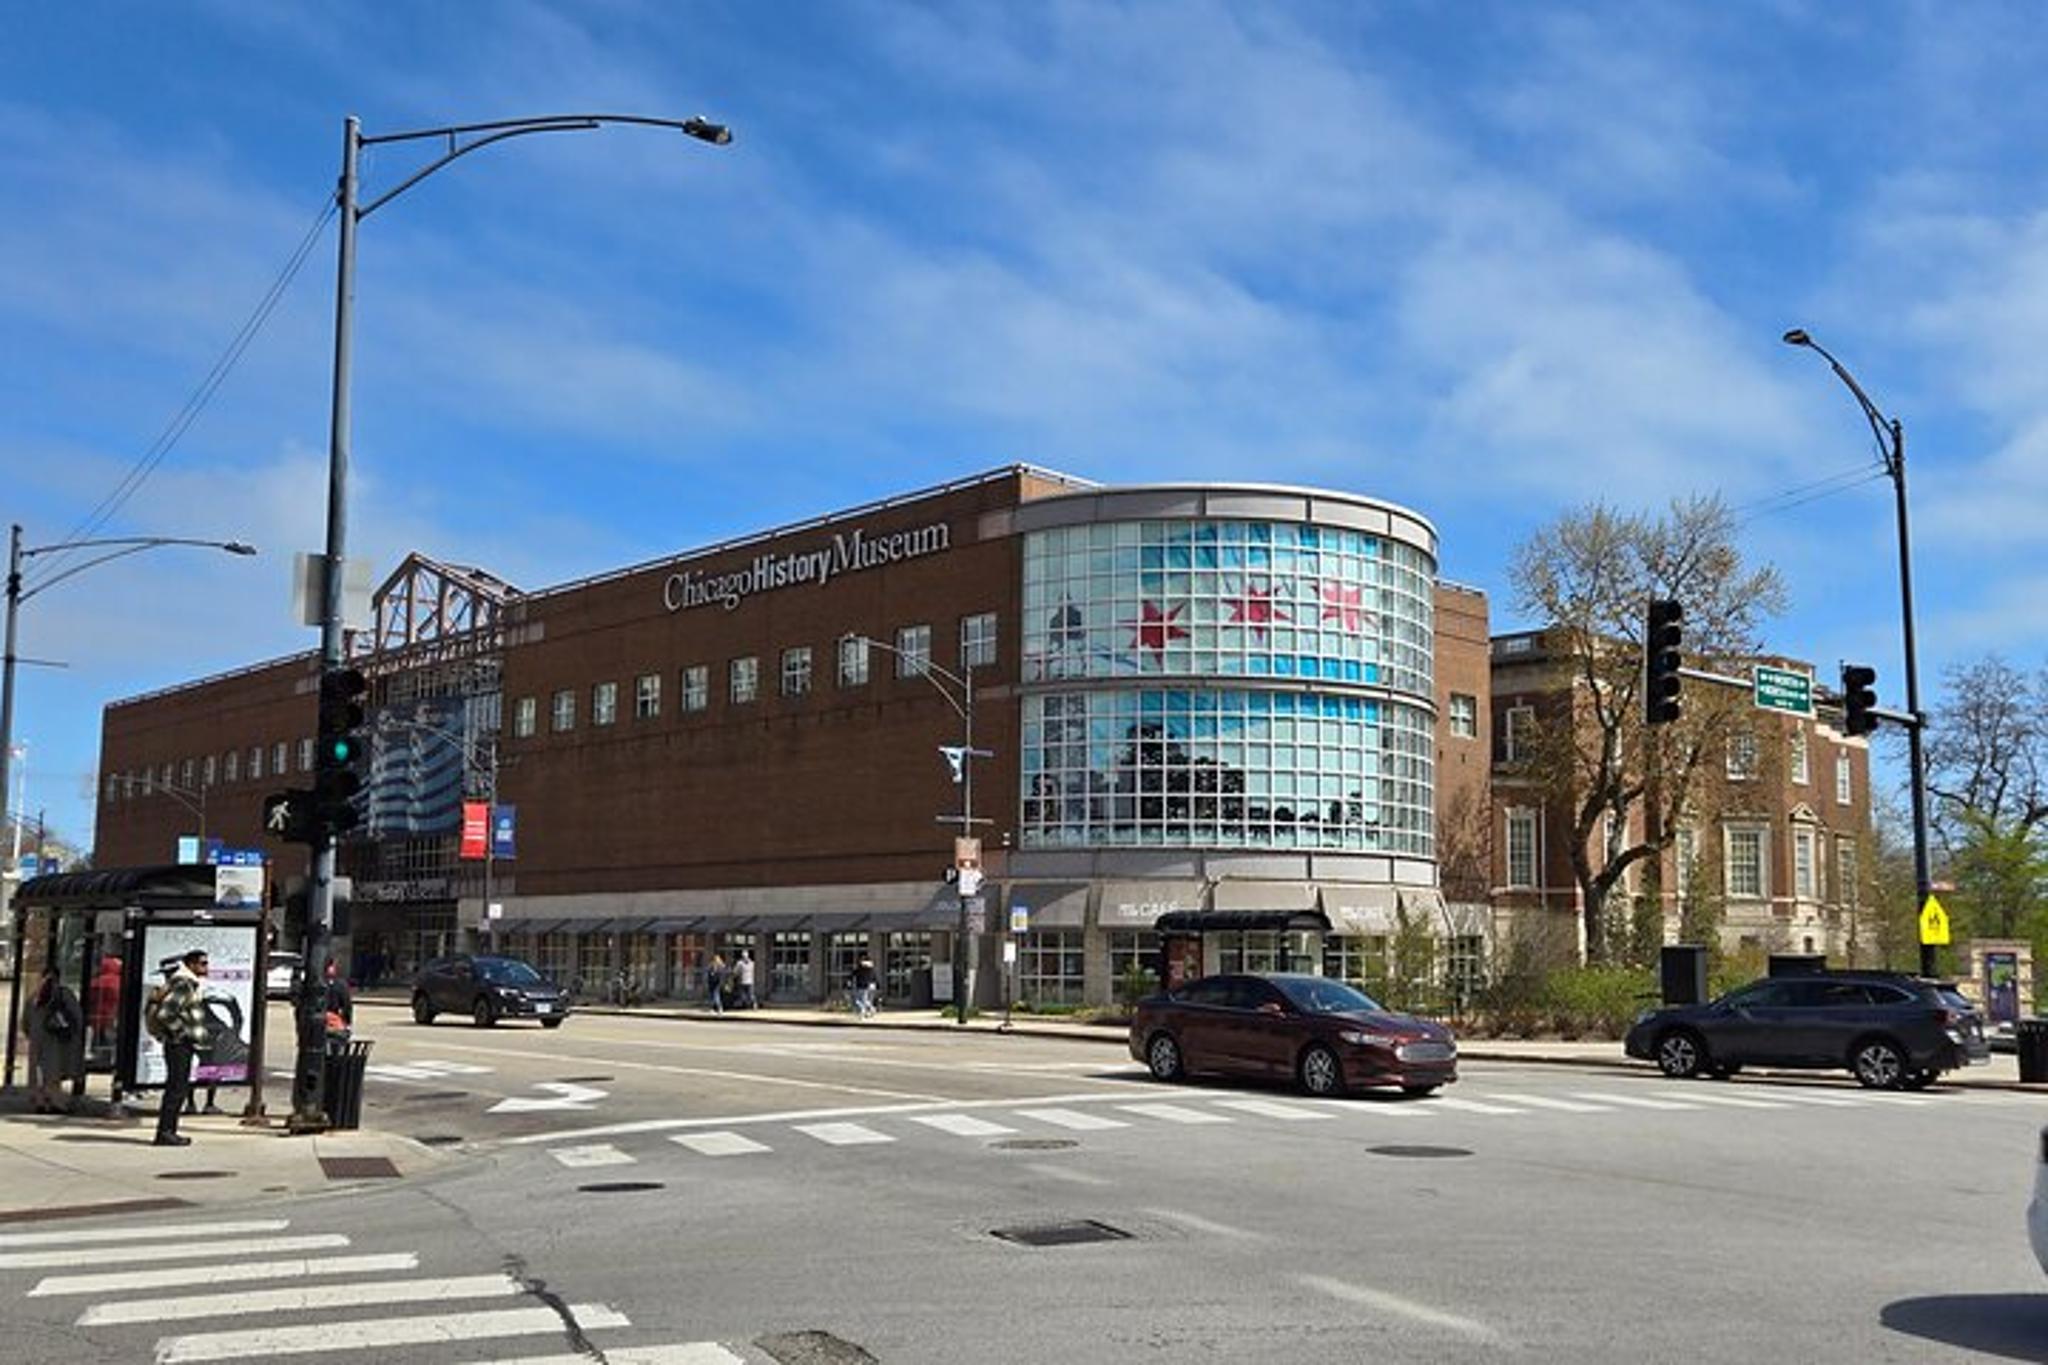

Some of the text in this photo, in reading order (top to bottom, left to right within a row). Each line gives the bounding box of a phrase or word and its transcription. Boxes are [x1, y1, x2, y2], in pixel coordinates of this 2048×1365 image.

[664, 522, 950, 611] Chicago History Museum
